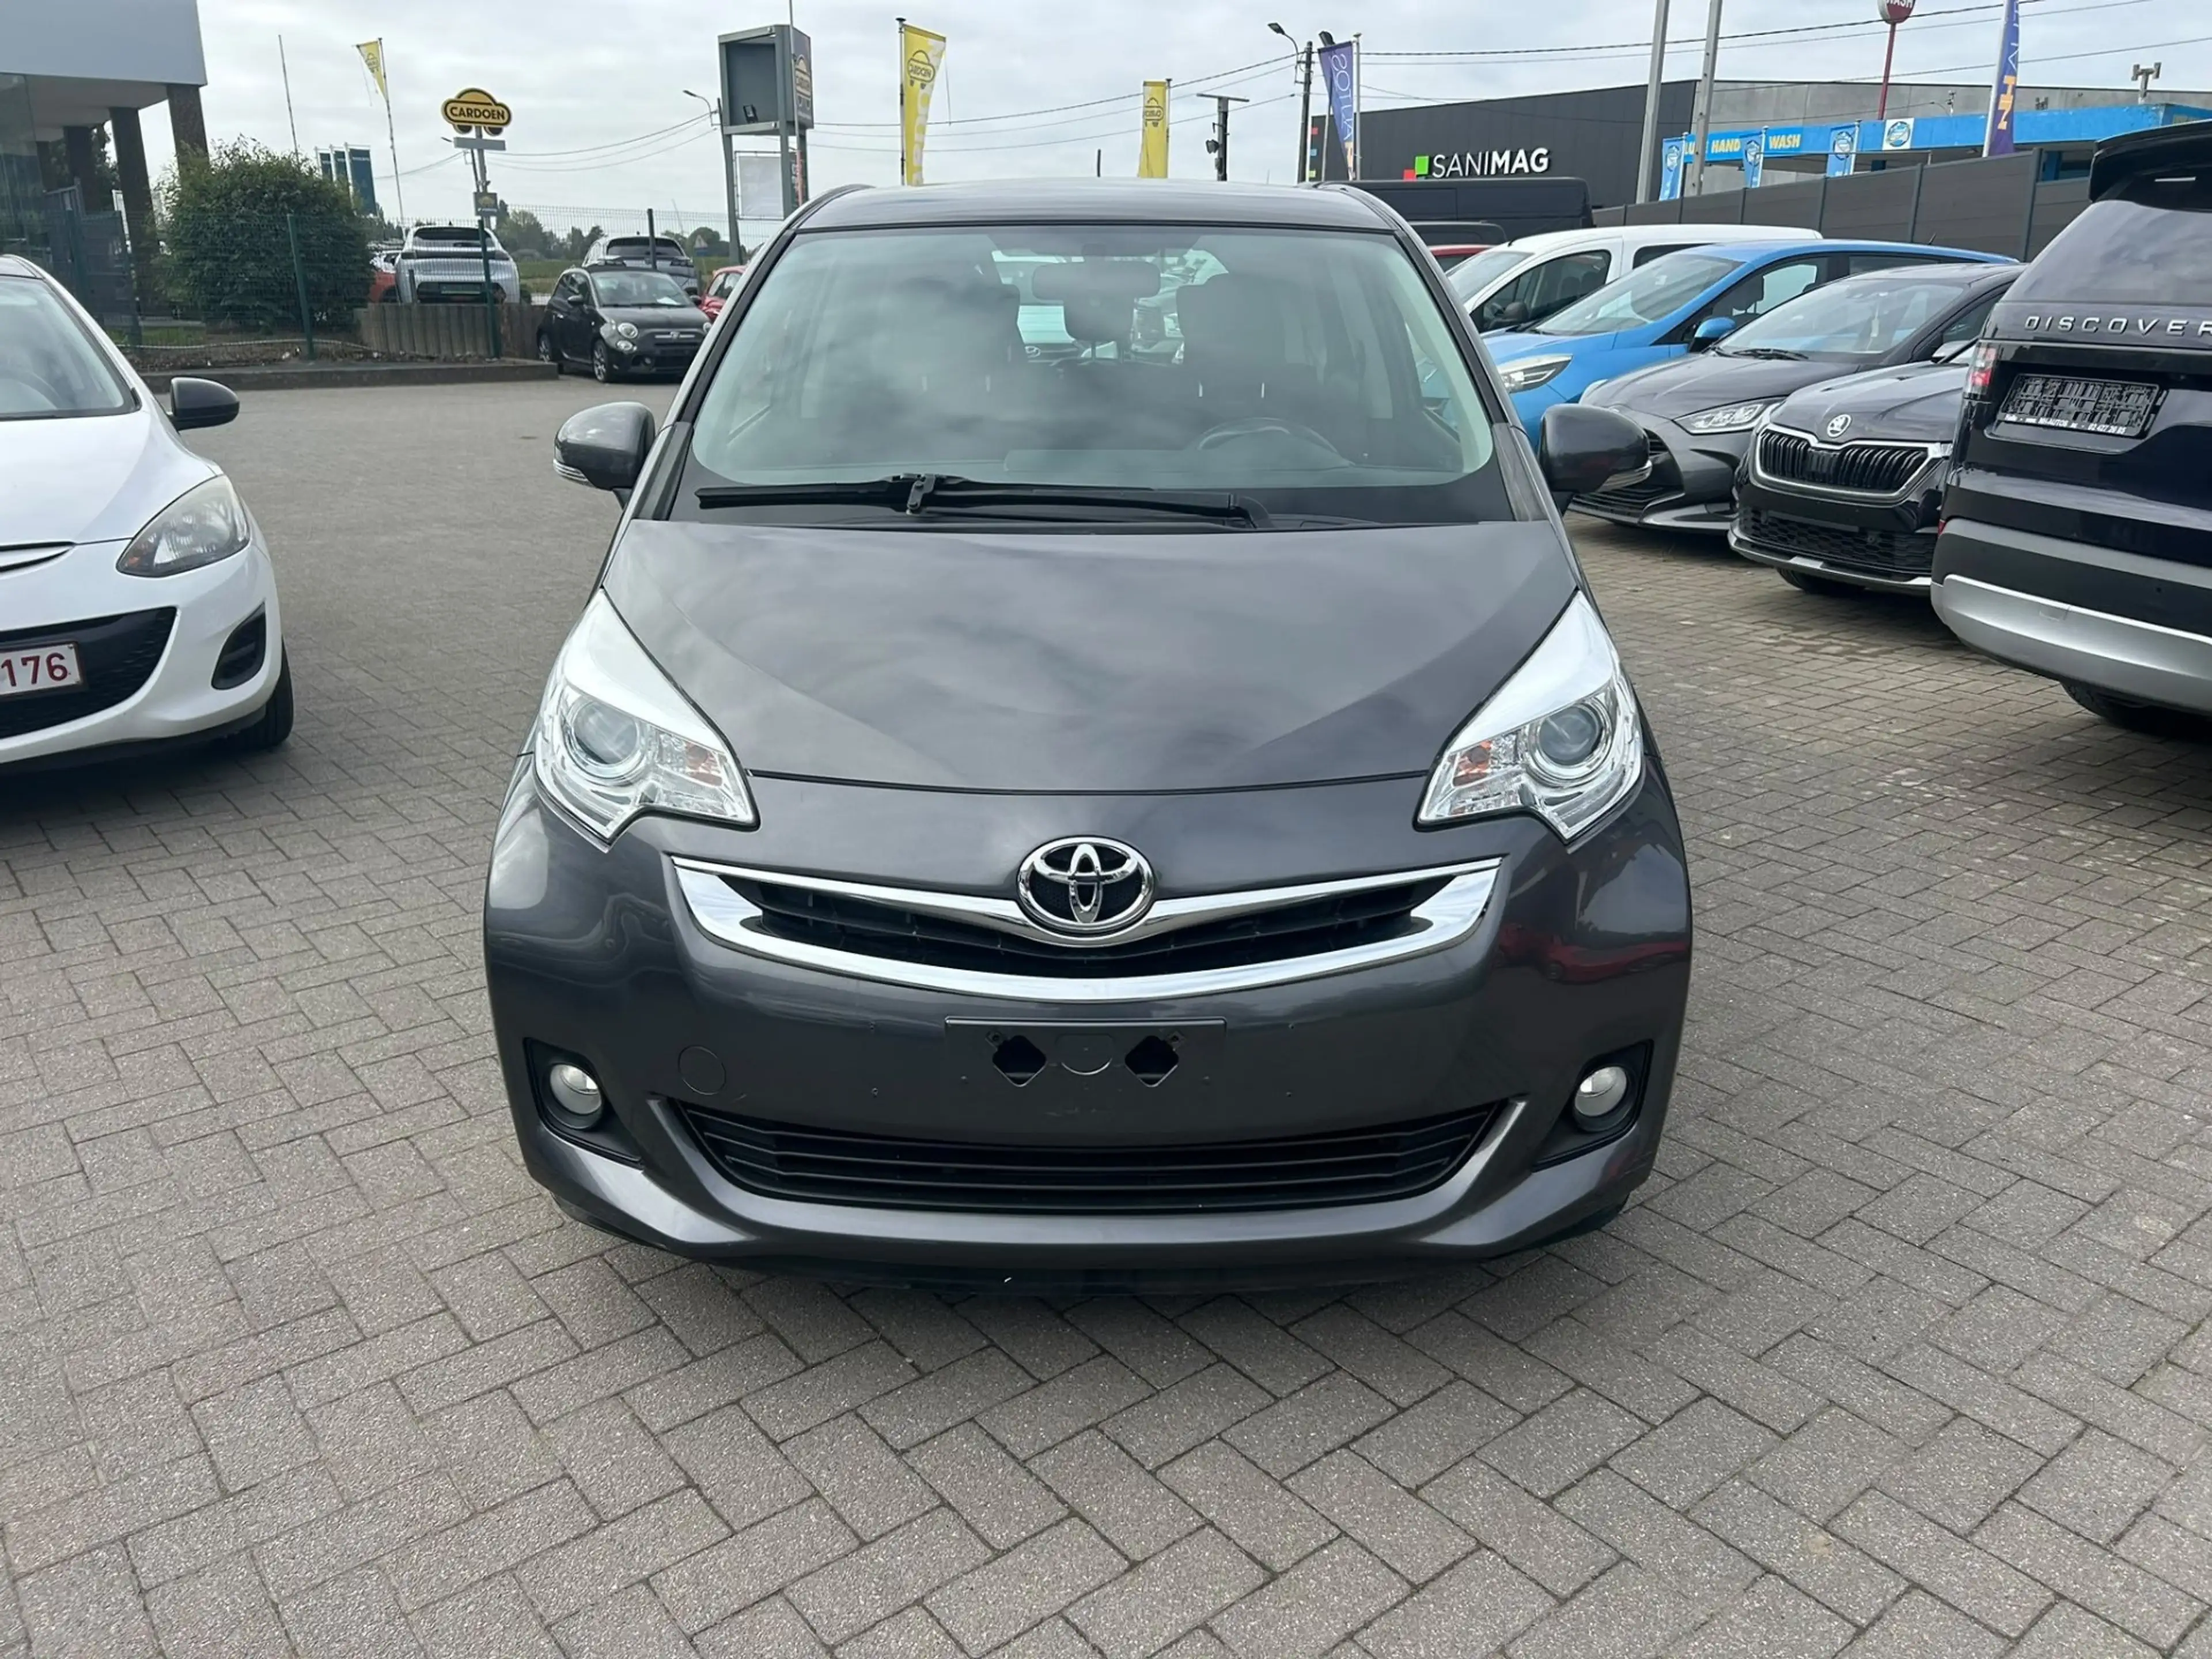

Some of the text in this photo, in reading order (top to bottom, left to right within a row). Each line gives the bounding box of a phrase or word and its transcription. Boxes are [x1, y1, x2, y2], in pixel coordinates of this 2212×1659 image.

[450, 106, 506, 120] CARDOEN
[1711, 138, 1741, 154] HAND
[1768, 134, 1802, 149] WASH
[1432, 147, 1549, 178] SANIMAG
[1, 652, 68, 687] 176
